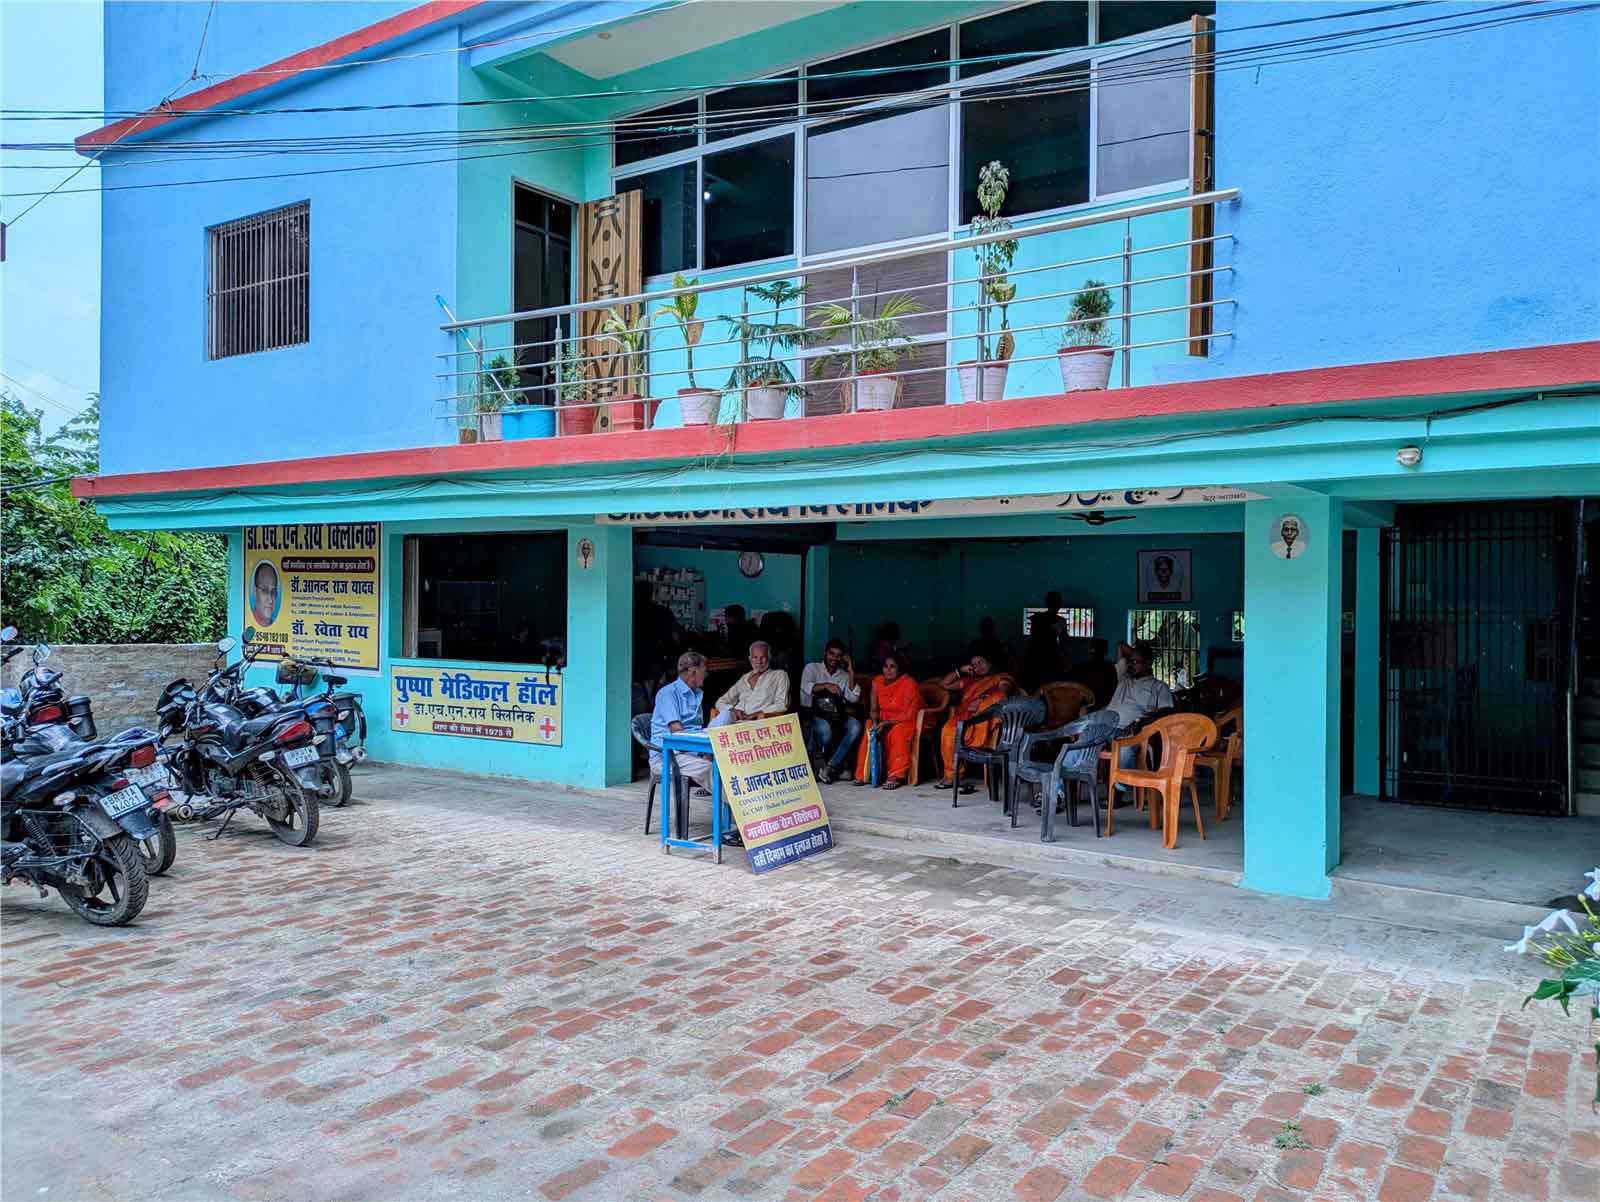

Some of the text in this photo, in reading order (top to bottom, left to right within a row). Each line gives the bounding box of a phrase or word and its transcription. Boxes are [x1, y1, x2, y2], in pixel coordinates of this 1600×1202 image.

[332, 580, 348, 594] राज
[352, 580, 374, 595] यादव
[291, 619, 308, 636] डॉ.
[346, 625, 369, 639] राय
[394, 672, 558, 706] पुष्पा मेडिकल हॉल
[491, 703, 536, 724] क्लिनिक
[772, 768, 789, 786] राज
